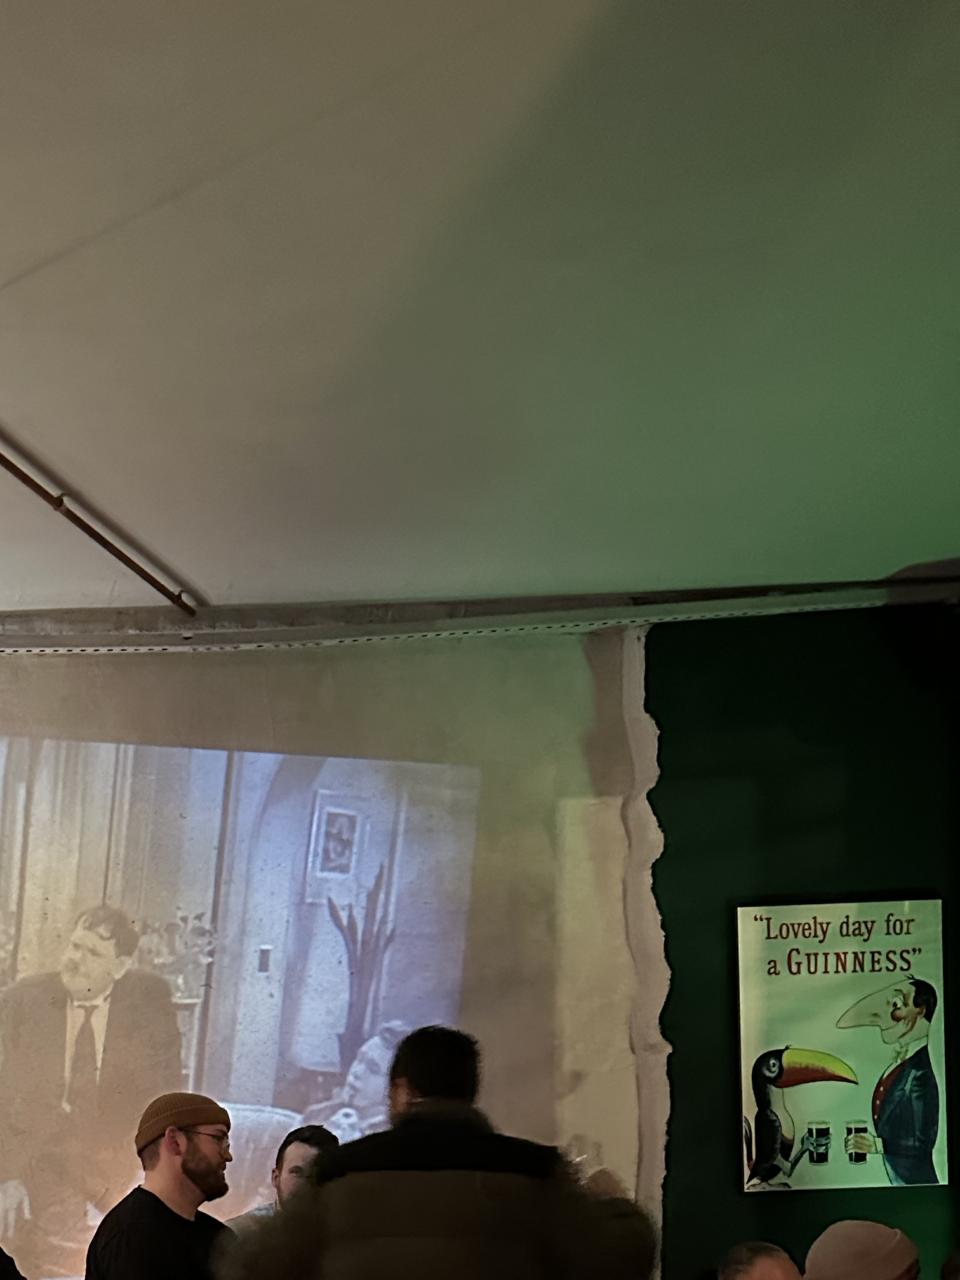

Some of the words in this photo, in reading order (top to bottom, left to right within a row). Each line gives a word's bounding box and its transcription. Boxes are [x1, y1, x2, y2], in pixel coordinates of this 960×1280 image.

[753, 914, 831, 943] “Lovely
[839, 914, 877, 942] day
[884, 913, 915, 936] for
[767, 958, 781, 976] a
[787, 947, 922, 975] GUINNESS”
